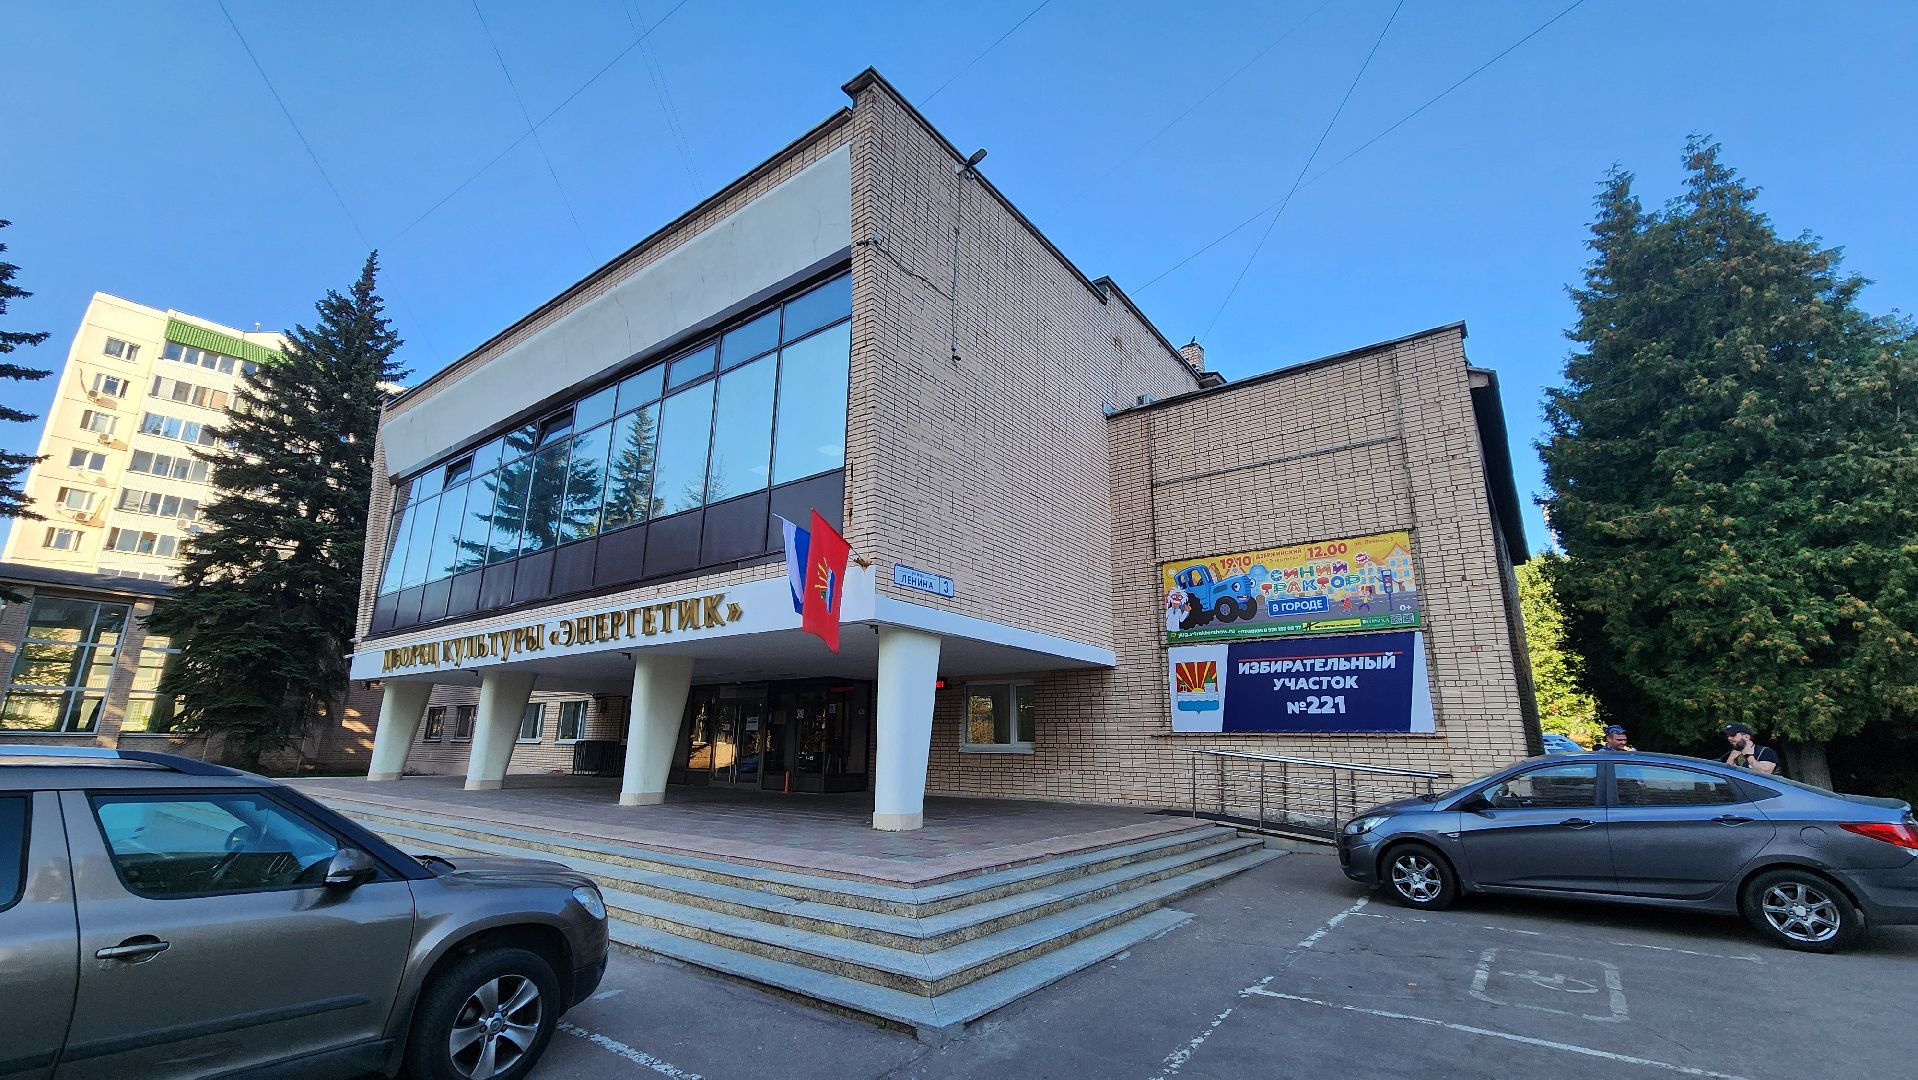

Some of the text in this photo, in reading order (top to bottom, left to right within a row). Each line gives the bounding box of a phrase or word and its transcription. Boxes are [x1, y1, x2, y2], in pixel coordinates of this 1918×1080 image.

[1256, 548, 1302, 560] ДЗЕРЖИНСКИЙ
[1307, 543, 1348, 558] 12.00
[1270, 562, 1348, 582] СИНИЙ
[902, 574, 948, 593] ЛЕНИНА 3
[1260, 574, 1360, 595] ТРАКТОР
[1272, 600, 1323, 612] В ГОРОДЕ
[382, 592, 743, 673] ДВОРЕЦ КУЛЬТУРЫ «ЭНЕРГЕТИК»
[1238, 652, 1396, 675] ИЗБИРАТЕЛЬНЫЙ
[1274, 676, 1358, 691] УЧАСТОК
[1287, 696, 1346, 714] №221
